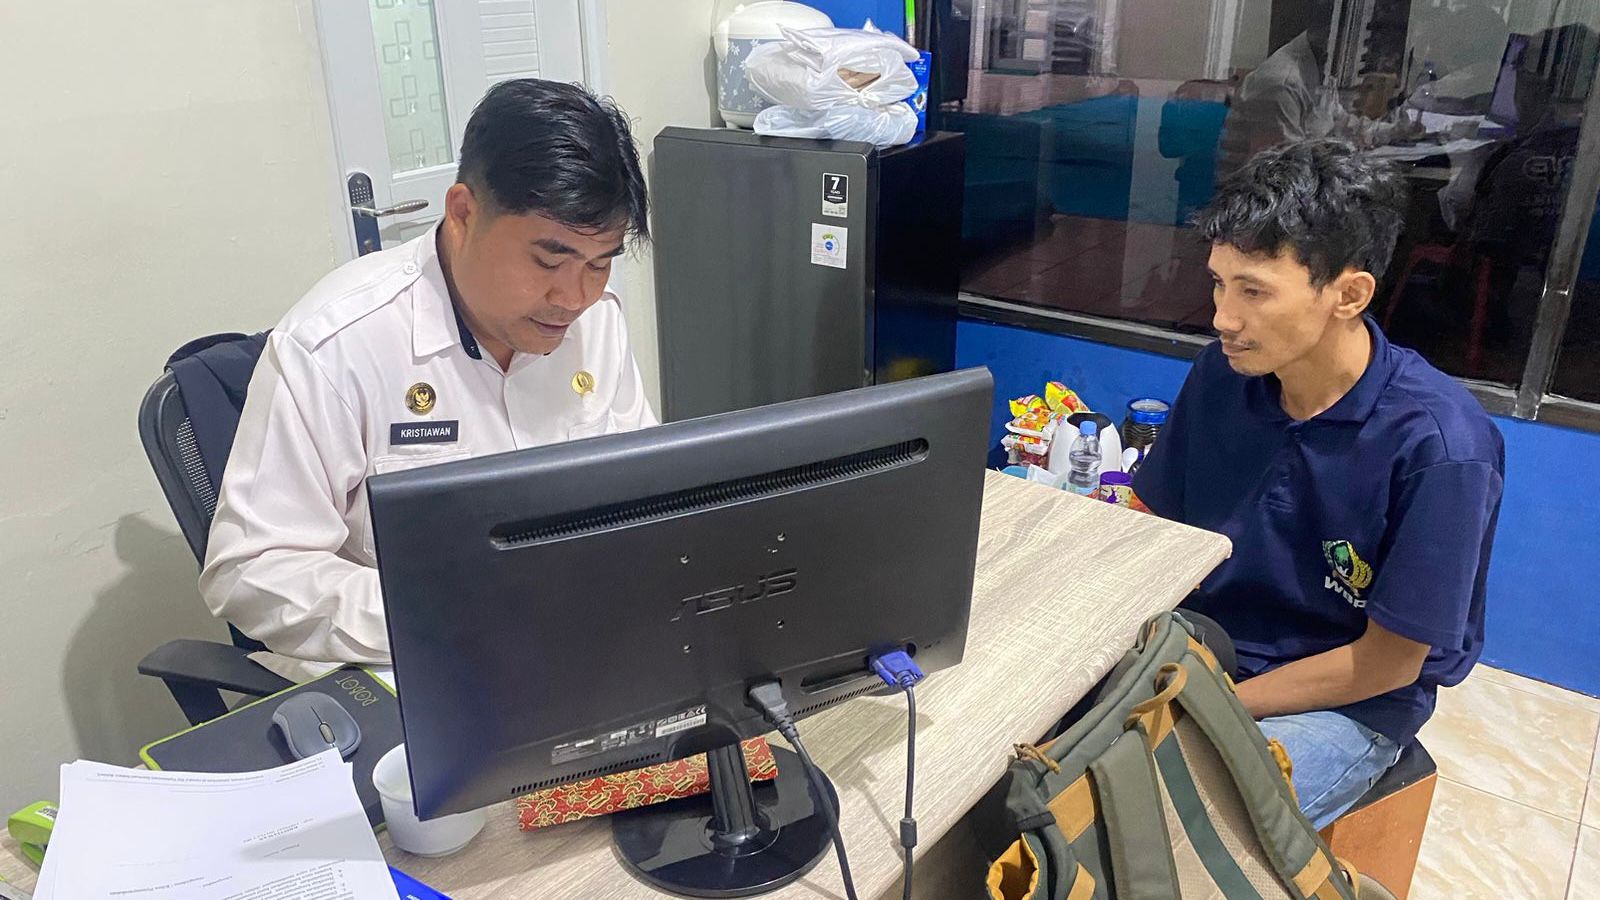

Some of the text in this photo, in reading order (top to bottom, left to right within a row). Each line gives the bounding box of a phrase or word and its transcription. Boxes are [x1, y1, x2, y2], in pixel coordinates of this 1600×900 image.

[831, 176, 840, 190] 7
[400, 426, 451, 438] KRISTIAWAN
[670, 568, 798, 622] ASUS
